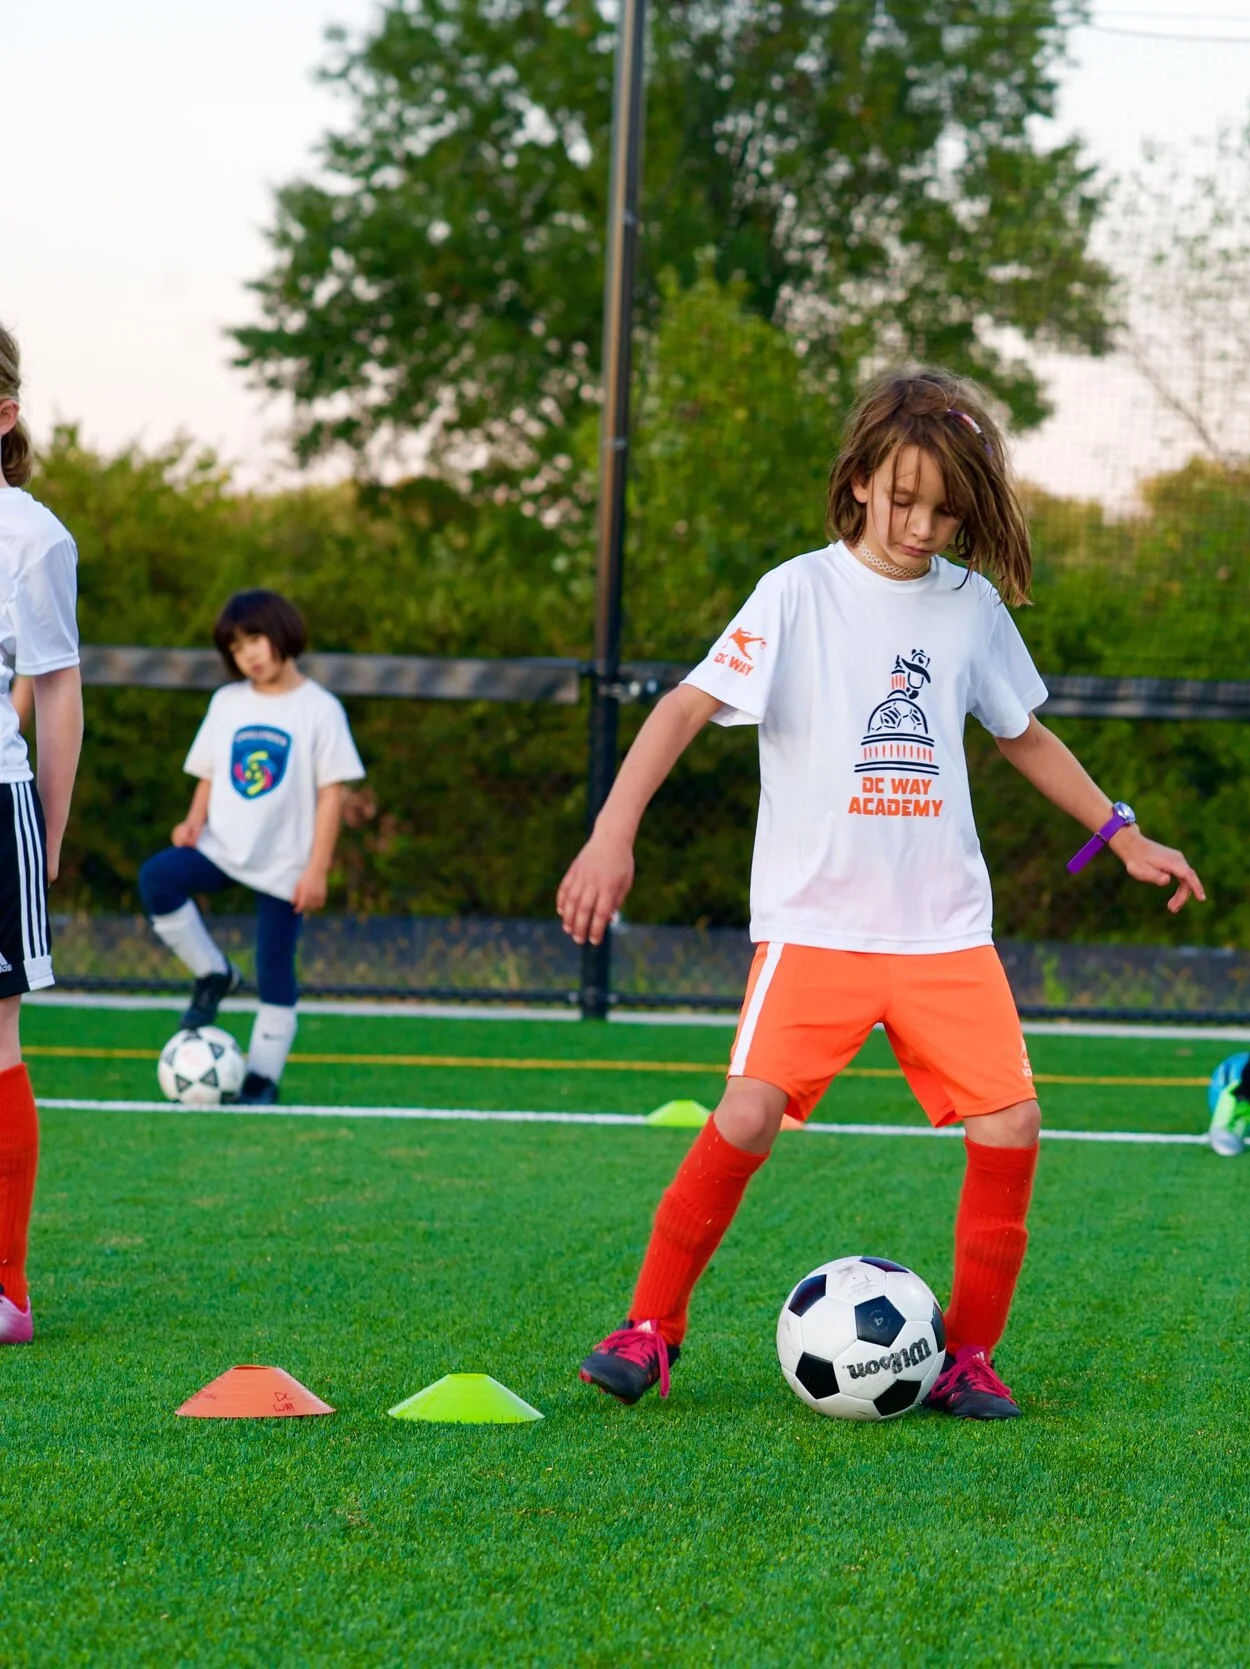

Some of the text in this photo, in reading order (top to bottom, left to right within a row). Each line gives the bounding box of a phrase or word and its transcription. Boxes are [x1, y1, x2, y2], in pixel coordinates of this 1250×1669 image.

[729, 656, 754, 676] WAY
[862, 776, 932, 795] DC WAY
[848, 797, 943, 817] ACADEMY
[847, 1337, 932, 1379] Wilson
